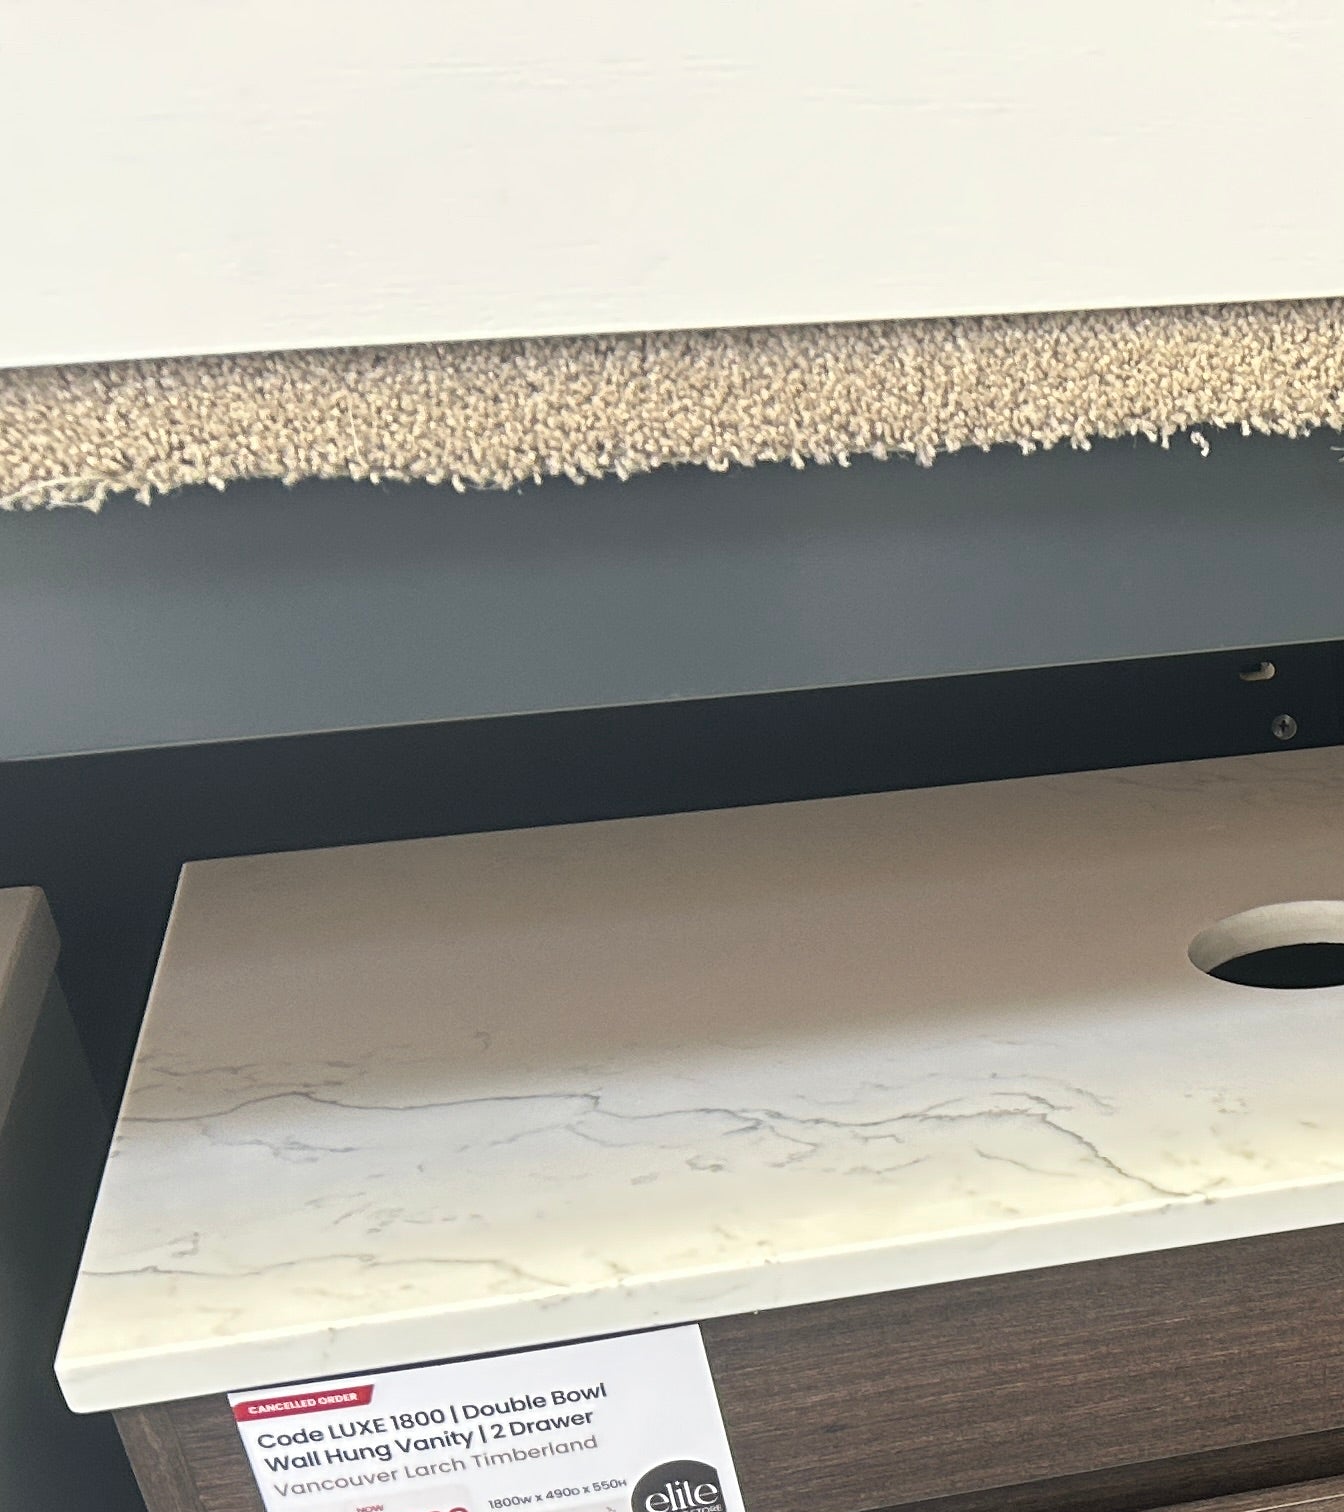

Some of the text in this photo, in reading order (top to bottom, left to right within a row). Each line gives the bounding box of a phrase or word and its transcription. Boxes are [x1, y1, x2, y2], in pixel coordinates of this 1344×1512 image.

[248, 1392, 358, 1414] CANCELLED ORDER
[257, 1428, 324, 1448] Code
[328, 1417, 388, 1440] LUXE
[390, 1408, 446, 1431] 1800
[462, 1394, 547, 1420] Double
[551, 1382, 608, 1405] Bowl
[264, 1450, 321, 1472] Wall
[324, 1443, 394, 1465] Hung
[395, 1430, 474, 1453] Vanity
[490, 1423, 507, 1440] 2
[509, 1411, 594, 1437] Drawer
[274, 1435, 599, 1498] Vancouver Larch Timberland
